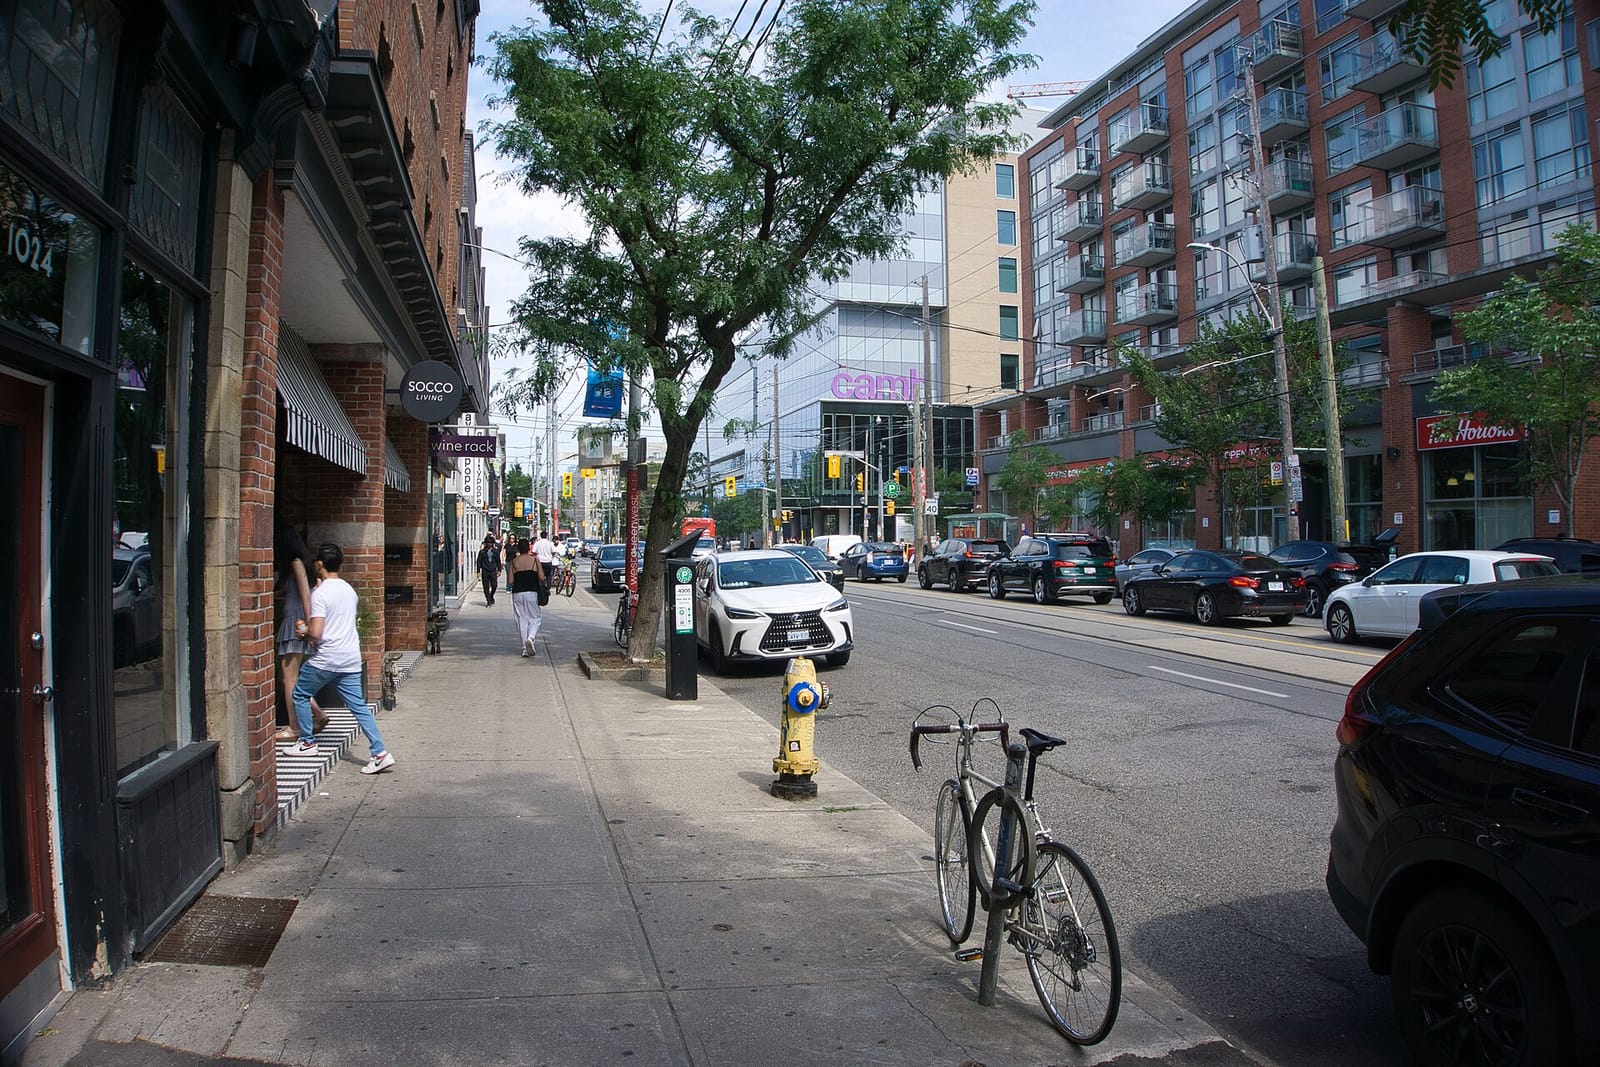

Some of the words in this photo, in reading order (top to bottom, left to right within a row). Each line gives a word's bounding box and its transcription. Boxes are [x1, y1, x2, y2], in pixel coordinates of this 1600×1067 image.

[8, 223, 53, 278] 1024
[408, 381, 454, 394] SOCCO
[415, 394, 444, 402] LIVING
[431, 439, 462, 452] wine
[464, 441, 494, 453] rack
[926, 505, 937, 513] 40
